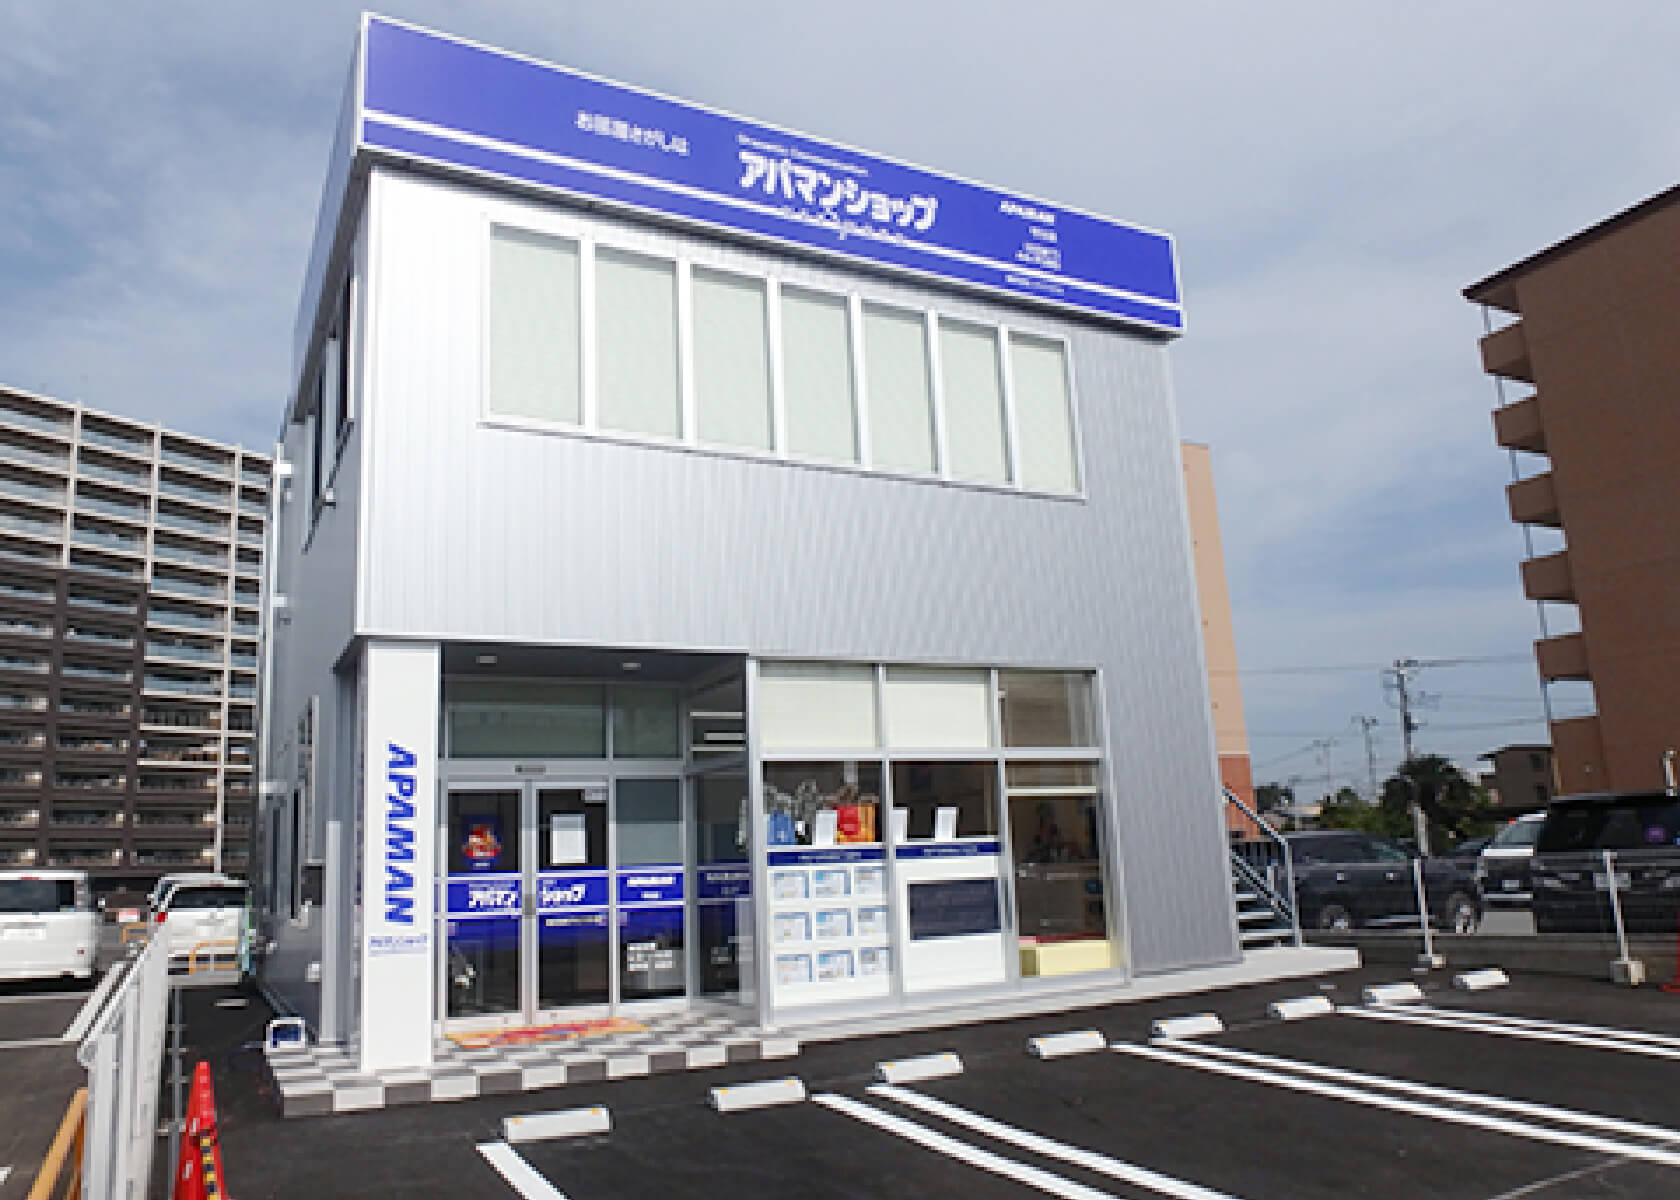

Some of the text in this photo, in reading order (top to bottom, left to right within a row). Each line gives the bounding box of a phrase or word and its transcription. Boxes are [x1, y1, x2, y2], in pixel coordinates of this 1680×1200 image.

[738, 151, 939, 231] アパマンショップ
[385, 740, 417, 926] APAMAN
